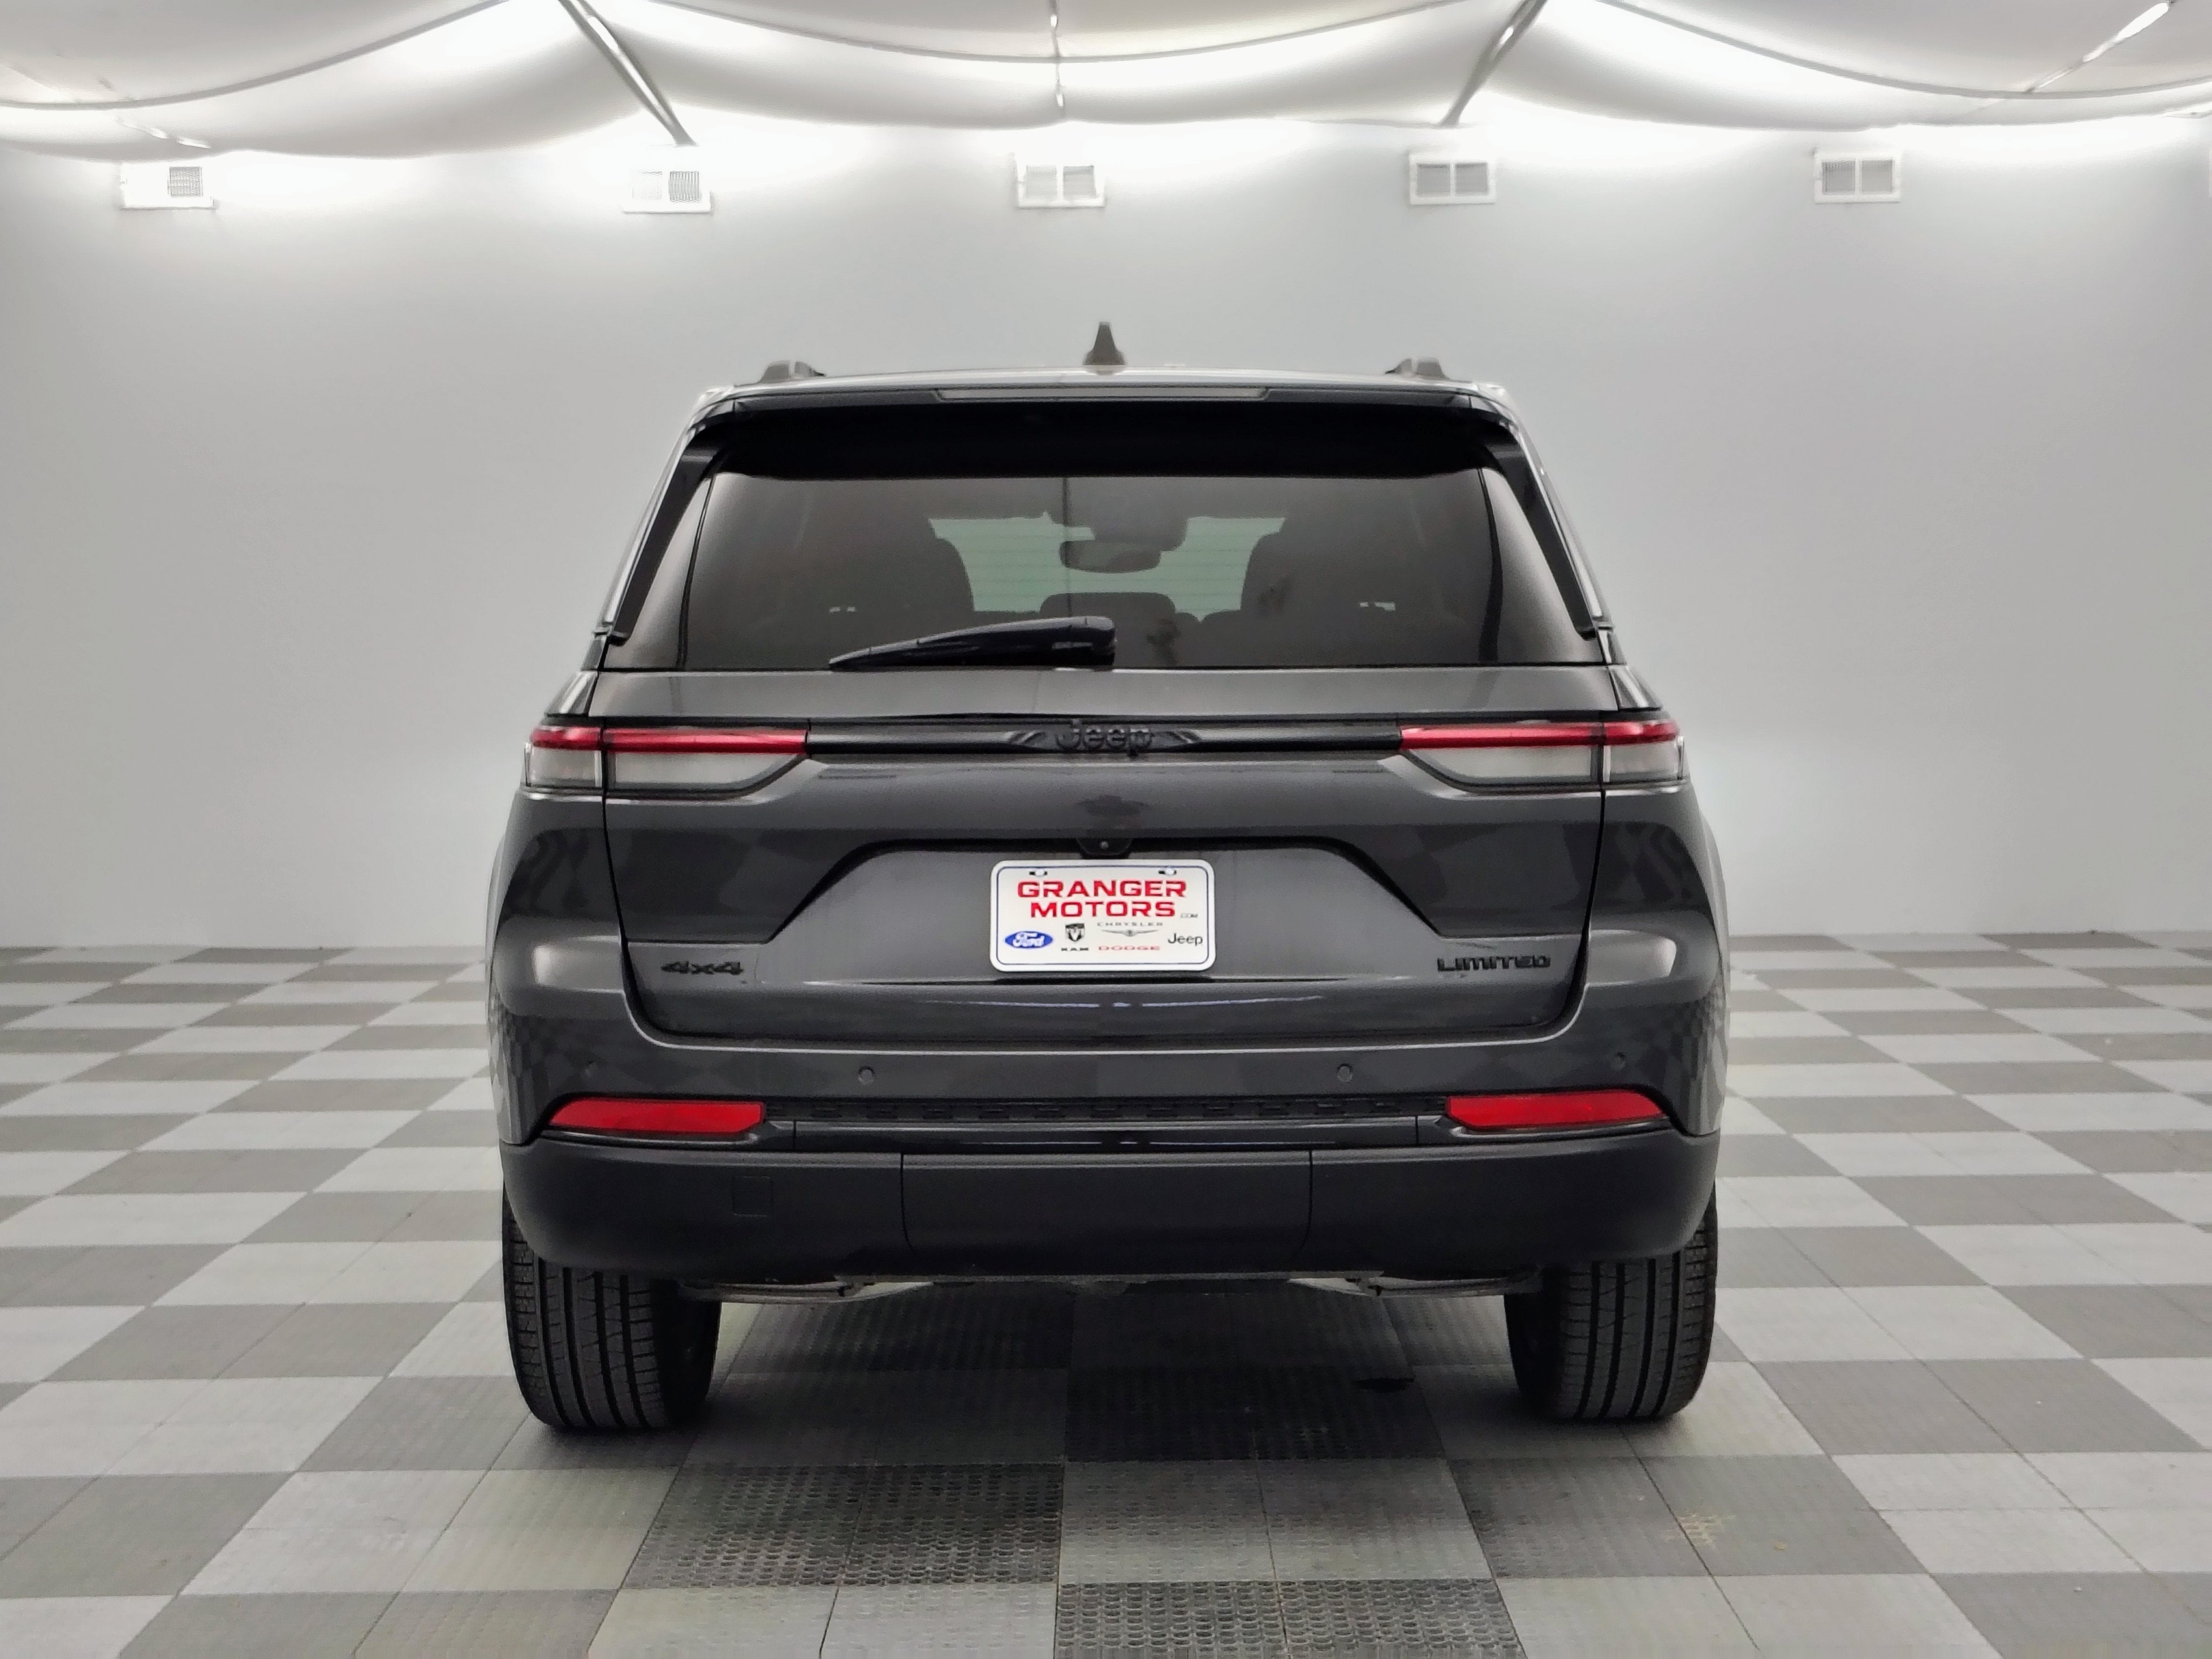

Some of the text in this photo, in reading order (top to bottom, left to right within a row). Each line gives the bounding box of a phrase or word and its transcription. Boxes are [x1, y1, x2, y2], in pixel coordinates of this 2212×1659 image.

[1057, 719, 1152, 757] Jeep
[1017, 880, 1186, 898] GRANGER
[1030, 901, 1175, 918] MOTORS
[1013, 932, 1044, 947] Ford
[1168, 933, 1203, 946] Jeep
[1437, 955, 1551, 971] LIMITED
